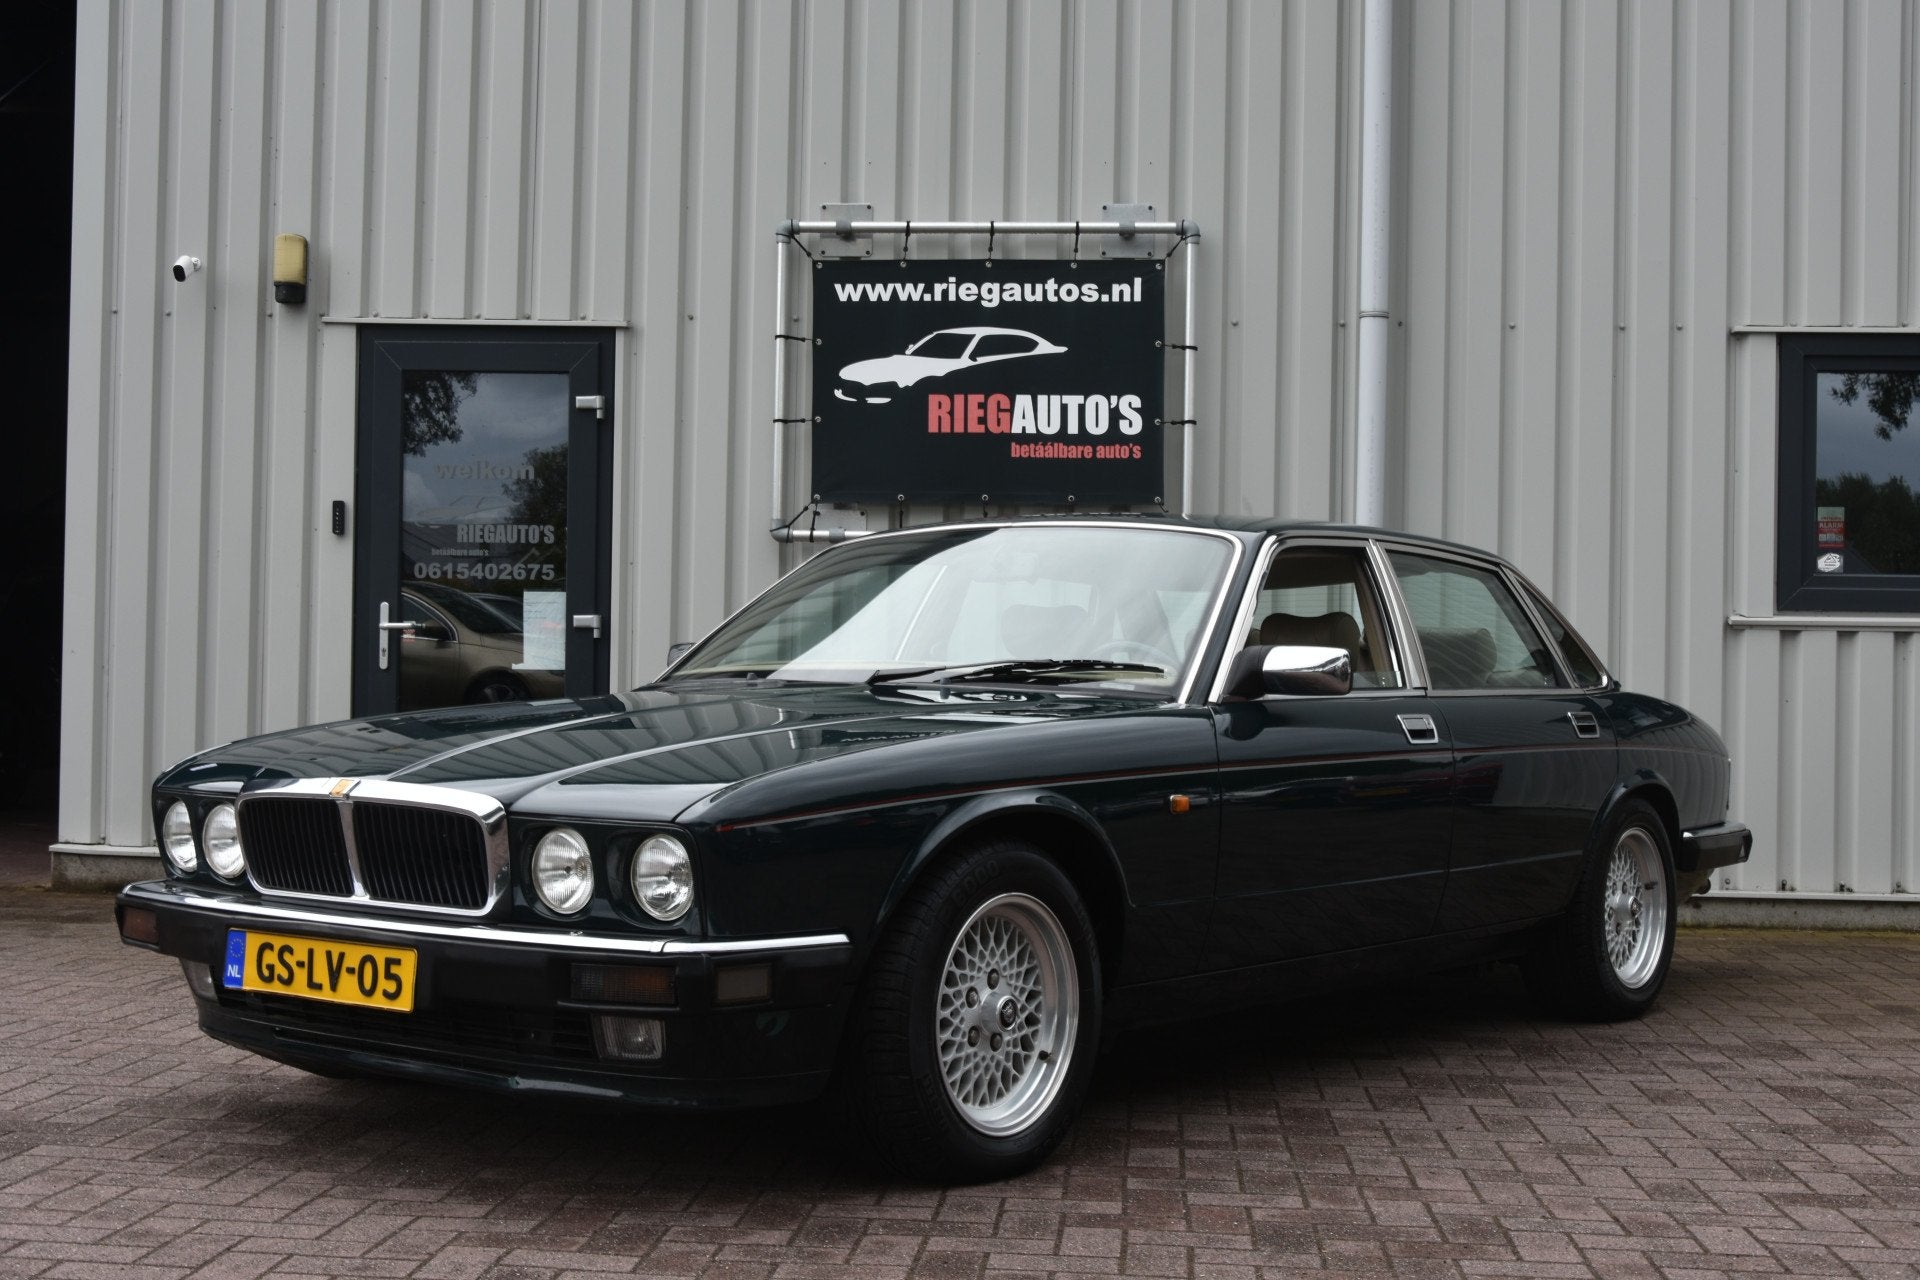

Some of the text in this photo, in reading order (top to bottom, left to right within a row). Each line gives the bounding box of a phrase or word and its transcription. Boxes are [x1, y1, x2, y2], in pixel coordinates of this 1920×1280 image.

[834, 276, 1142, 308] www.riegautos.nl
[928, 393, 1143, 436] RIEGAUTO'S
[1011, 442, 1142, 459] betáálbare auto's
[434, 460, 536, 480] welkom
[456, 524, 555, 544] RIEGAUTO'S
[413, 562, 555, 581] 0615402675
[227, 964, 241, 978] NL
[256, 941, 403, 1001] GS-LV-05
